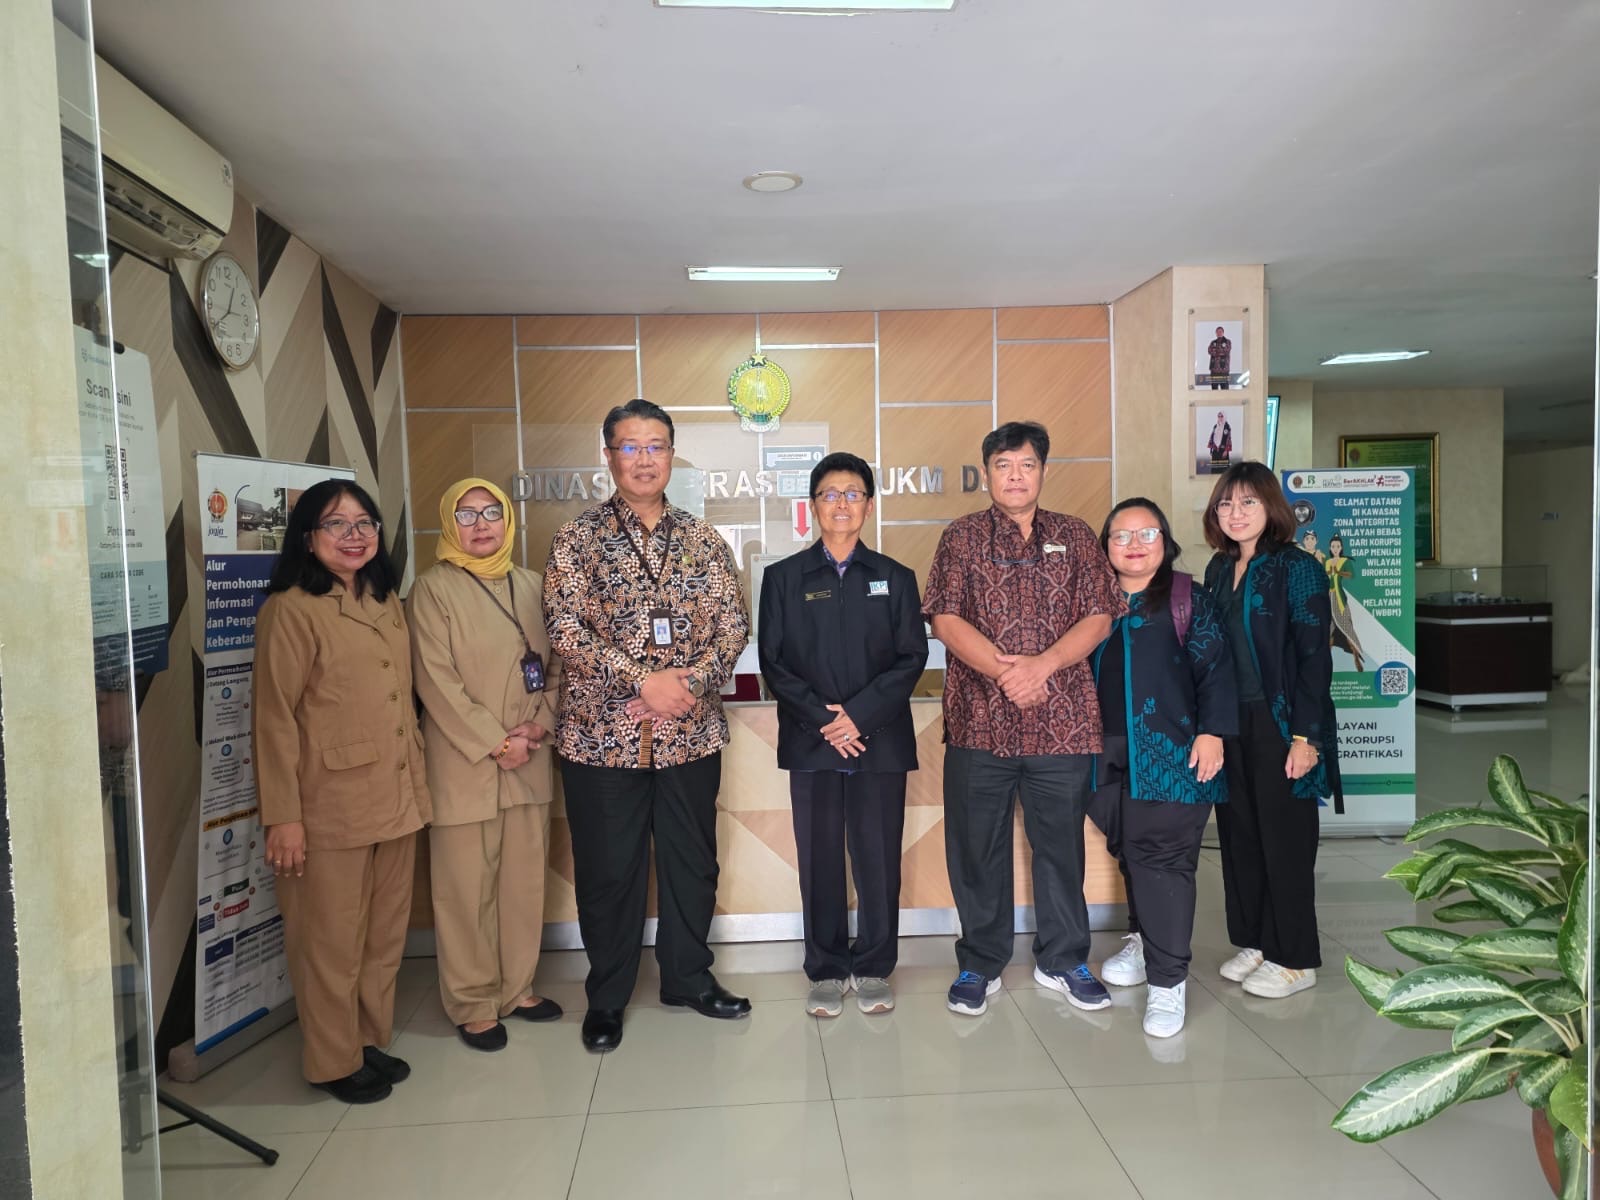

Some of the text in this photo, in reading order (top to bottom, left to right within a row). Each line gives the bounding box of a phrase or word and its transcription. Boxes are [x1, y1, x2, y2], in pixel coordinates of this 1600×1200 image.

[240, 294, 247, 308] 2
[244, 314, 249, 328] 3
[86, 378, 111, 400] Scan
[511, 471, 609, 501] DINAS
[876, 464, 944, 495] UKM
[1333, 497, 1402, 507] SELAMAT DATANG
[1352, 507, 1400, 517] DI KAWASAN
[1333, 517, 1400, 527] ZONA INTEGRITAS
[208, 525, 224, 537] jogja
[1340, 527, 1402, 537] WILAYAH BEBAS
[1349, 537, 1402, 547] DARI KORUPSI
[1351, 547, 1402, 557] SIAP MENUJU
[206, 559, 226, 572] Alur
[1367, 558, 1402, 567] WILAYAH
[1361, 568, 1402, 577] BIROKRASI
[1374, 578, 1402, 587] BERSIH
[1385, 588, 1402, 597] DAN
[207, 595, 254, 610] Informasi
[1363, 598, 1402, 607] MELAYANI
[1372, 608, 1402, 618] (WBBM)
[206, 615, 257, 629] dan Penga
[1337, 721, 1377, 731] LAYANI
[1346, 735, 1395, 745] KORUPSI
[1337, 749, 1403, 759] GRATIFIKASI
